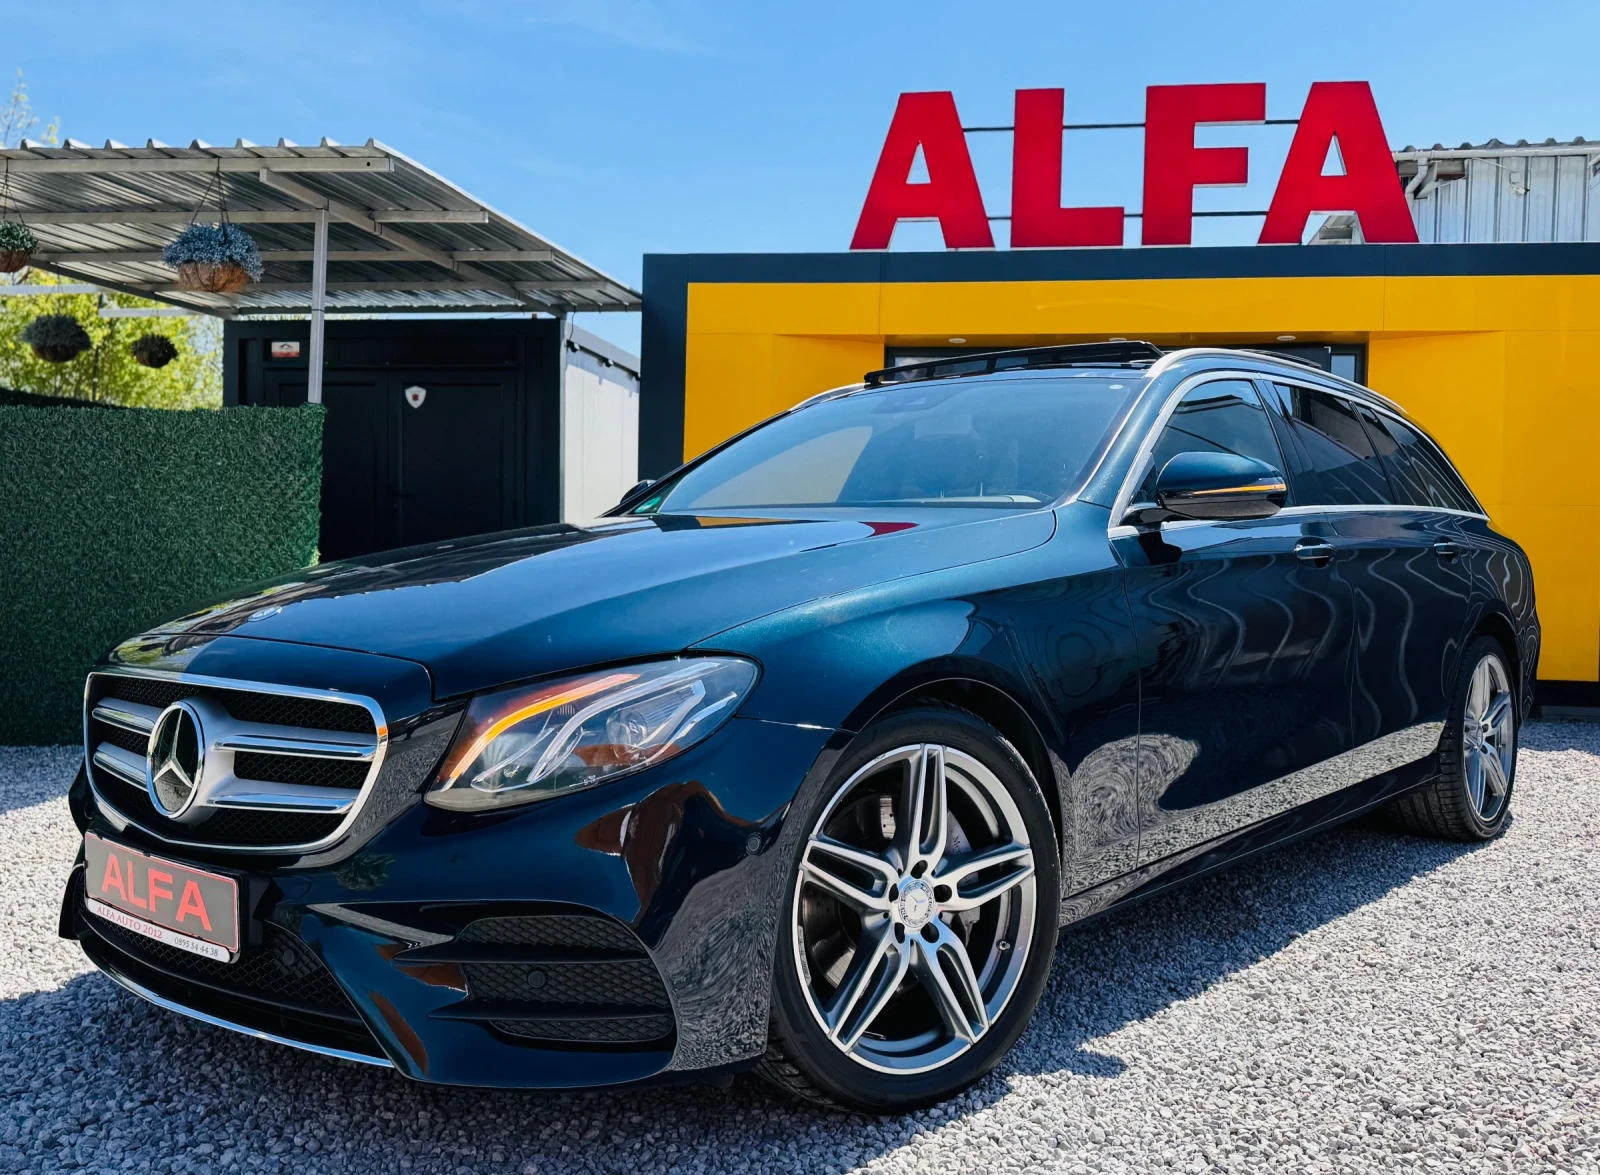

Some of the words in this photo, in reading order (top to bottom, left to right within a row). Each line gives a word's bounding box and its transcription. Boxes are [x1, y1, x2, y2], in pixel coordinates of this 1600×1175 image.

[849, 81, 1420, 250] ALFA
[101, 853, 212, 932] ALFA
[97, 906, 115, 920] ALFA
[117, 915, 141, 930] AUTO
[142, 925, 163, 939] 2012
[174, 937, 189, 948] 0895
[190, 942, 199, 951] 54
[200, 945, 209, 954] 44
[210, 947, 219, 957] 38
